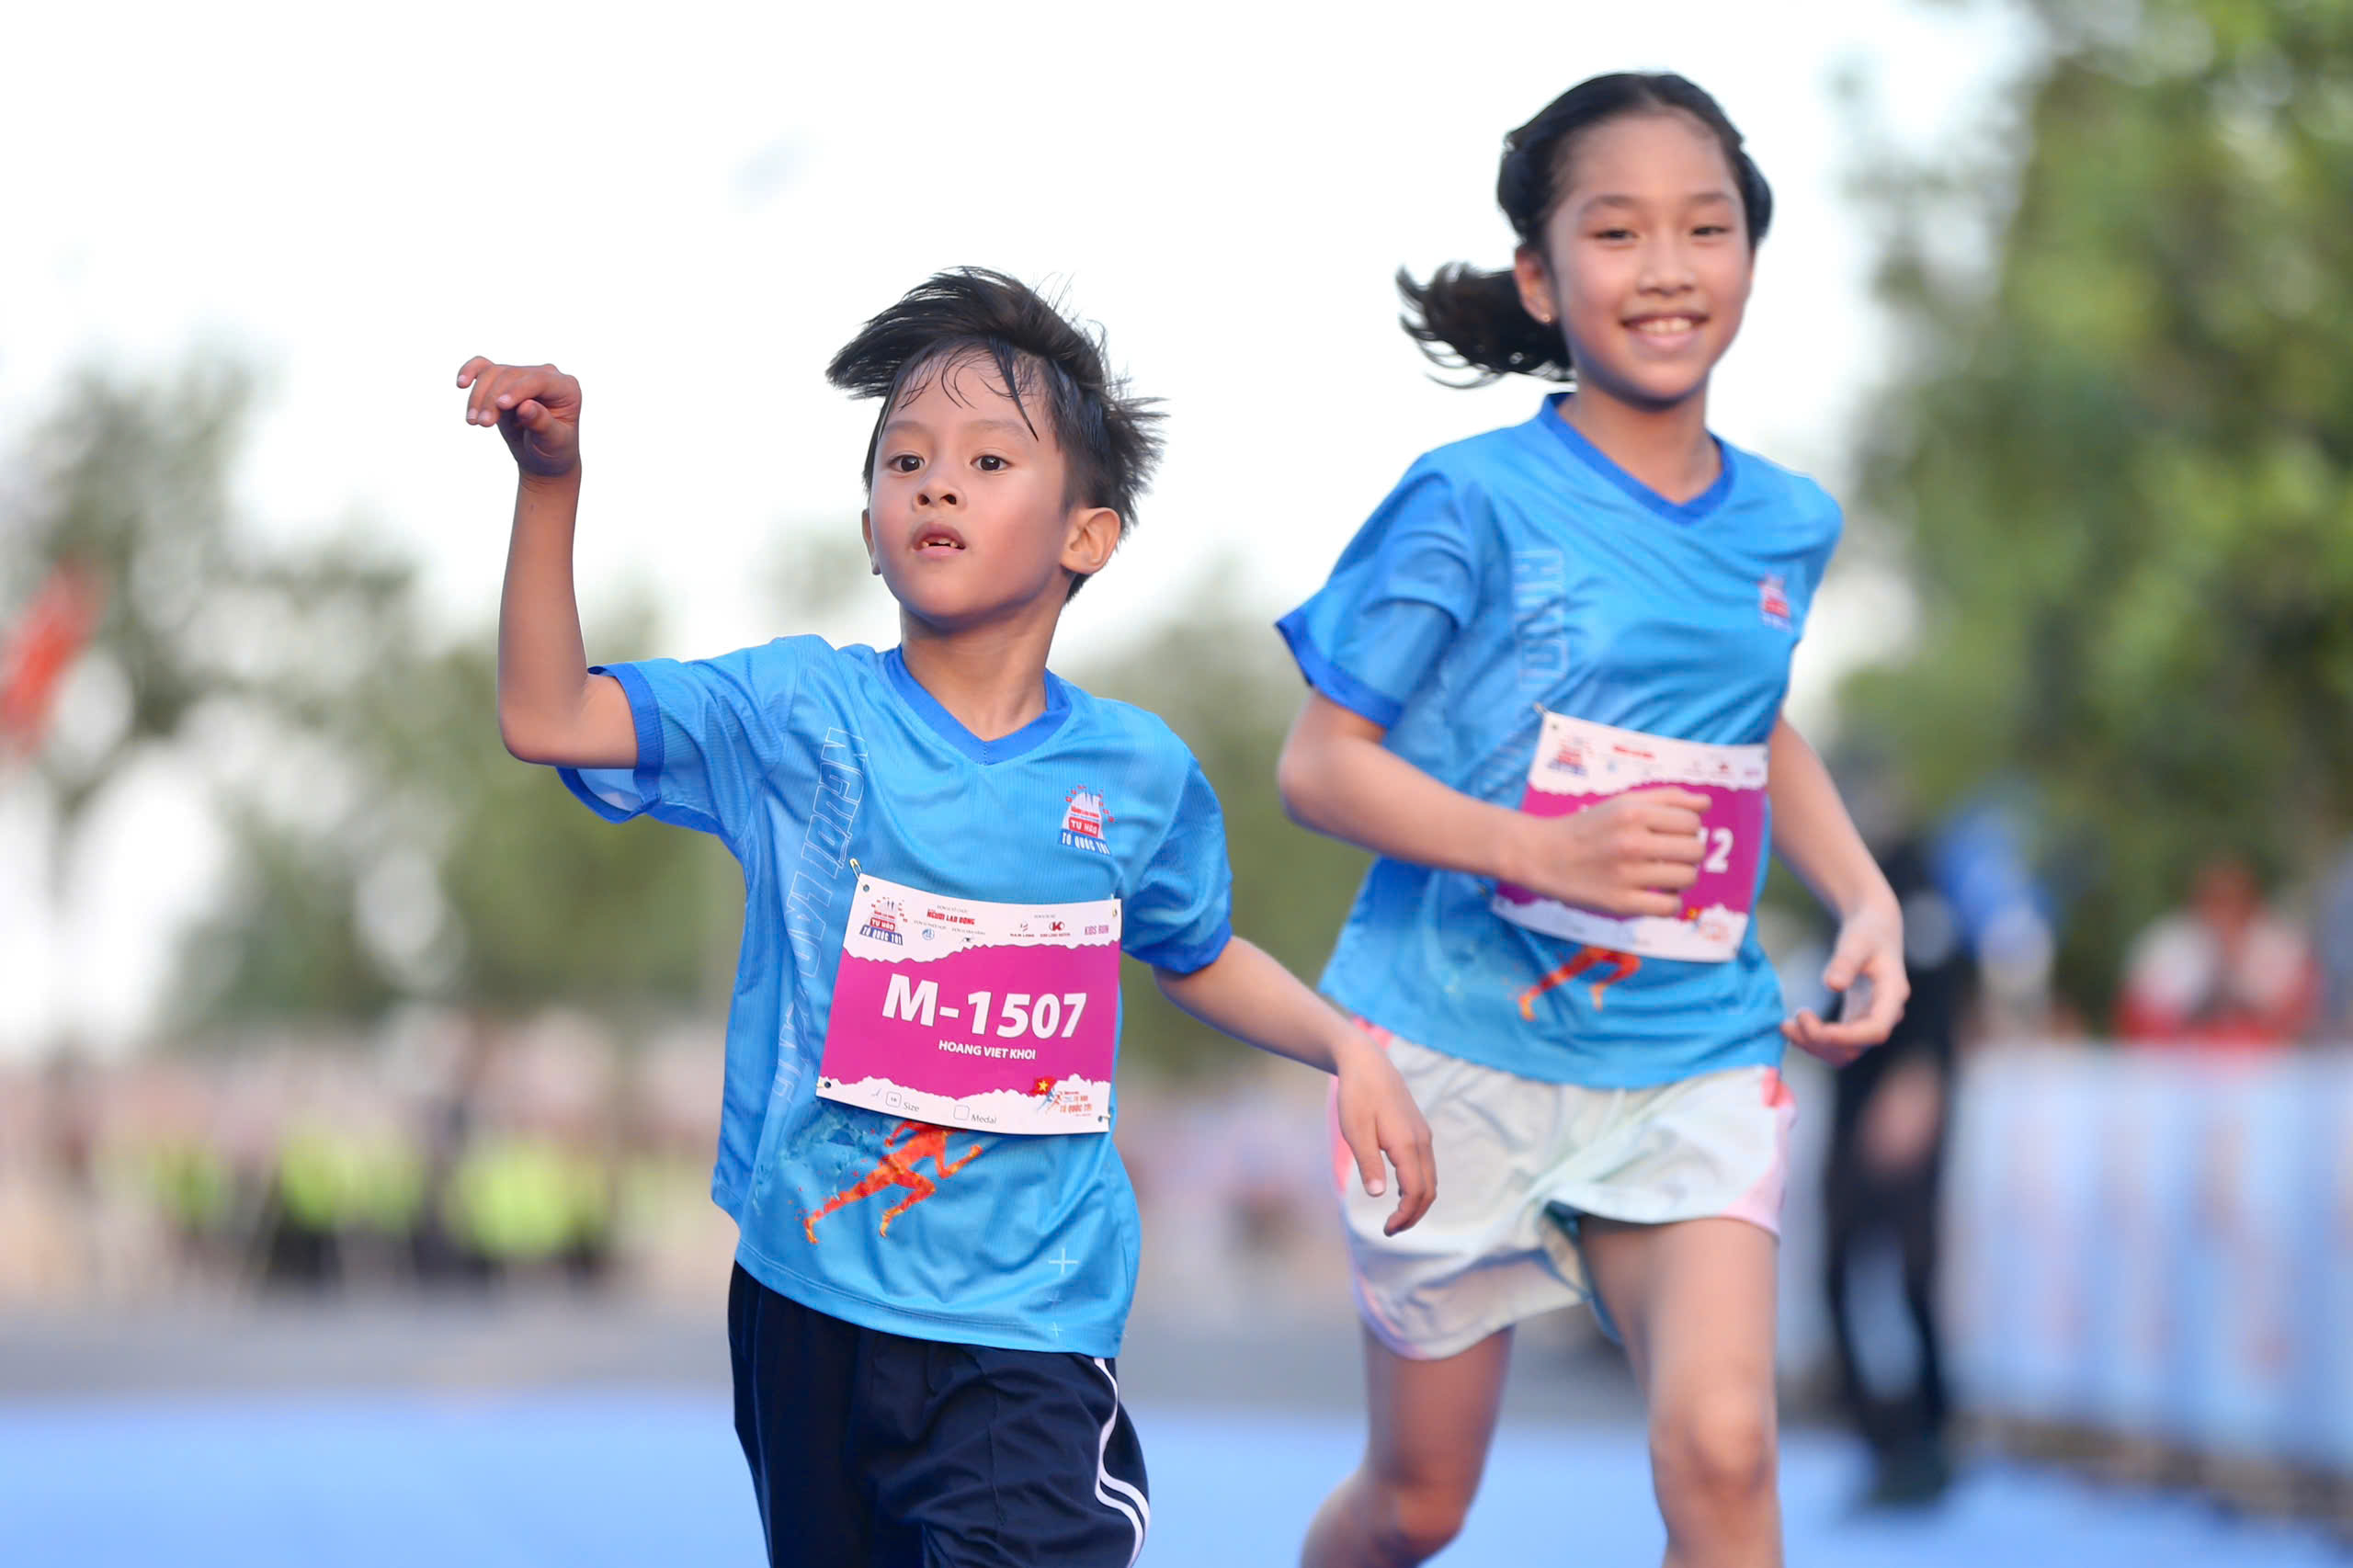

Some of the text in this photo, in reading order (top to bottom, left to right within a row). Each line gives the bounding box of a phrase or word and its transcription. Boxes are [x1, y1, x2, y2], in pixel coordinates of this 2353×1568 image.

[881, 972, 1087, 1040] M-1507
[938, 1040, 1037, 1060] HOANG VIET KHOI
[904, 1101, 920, 1112] Size
[971, 1114, 997, 1124] Medal
